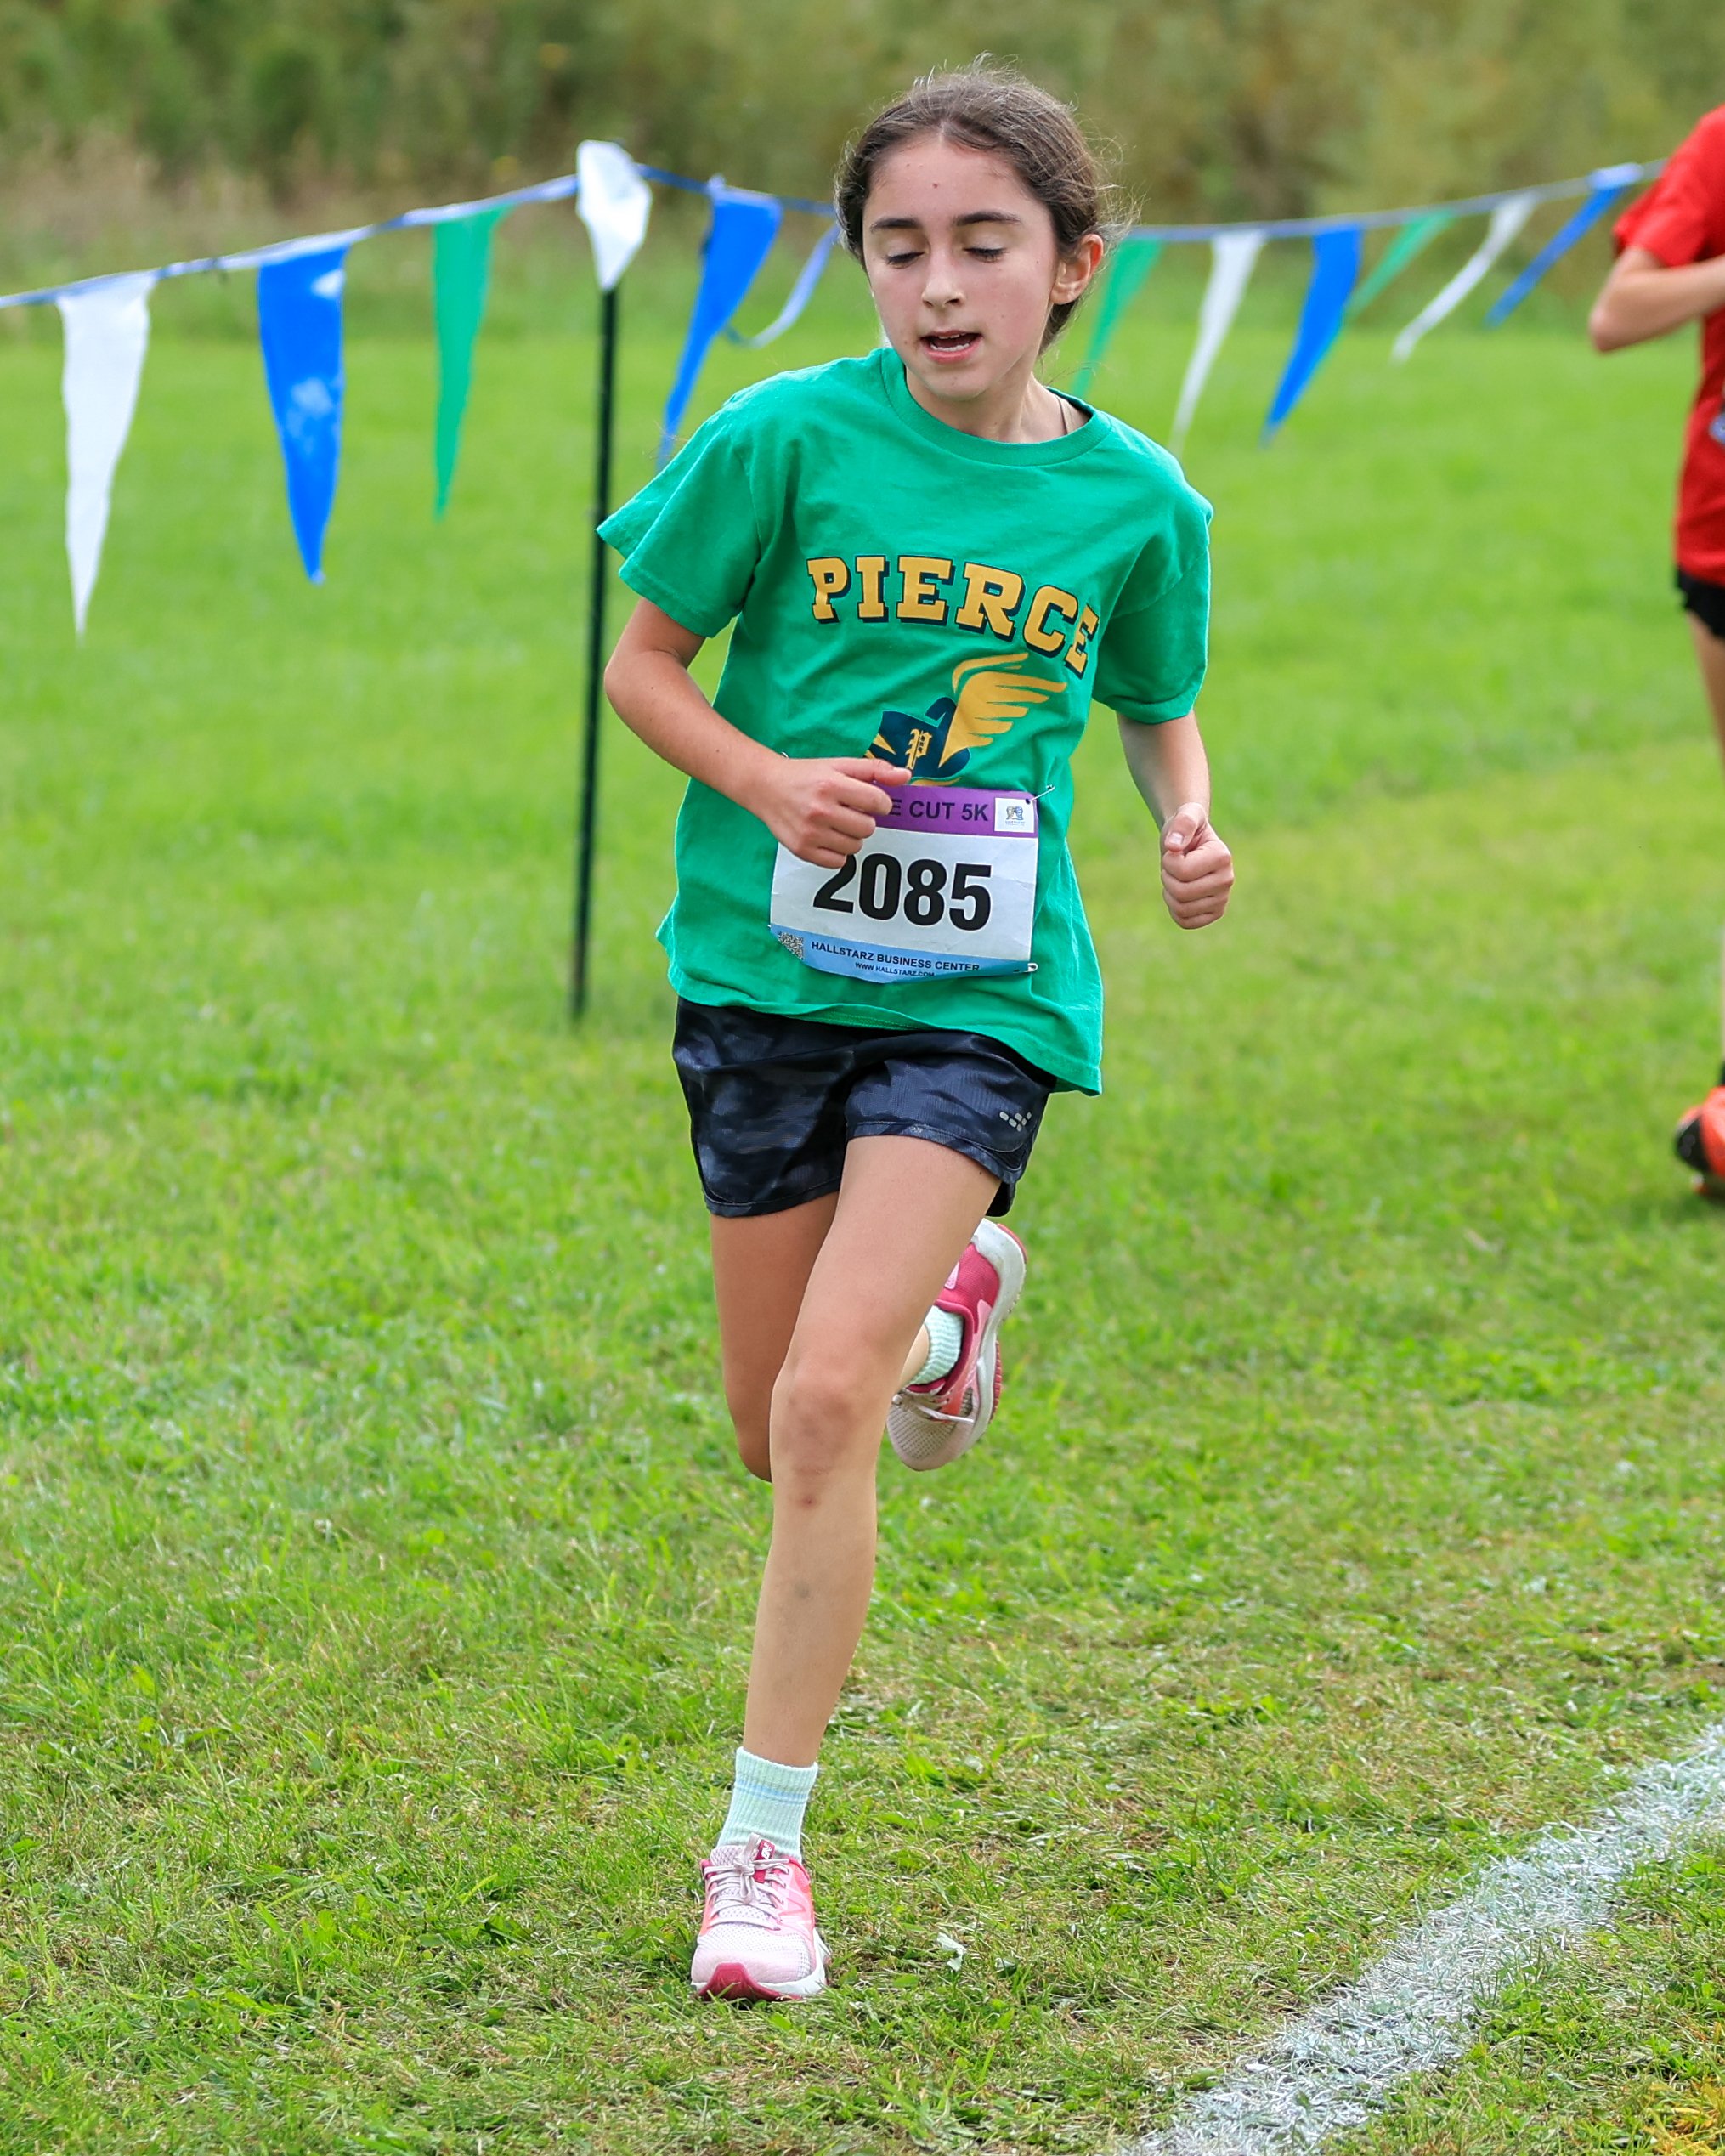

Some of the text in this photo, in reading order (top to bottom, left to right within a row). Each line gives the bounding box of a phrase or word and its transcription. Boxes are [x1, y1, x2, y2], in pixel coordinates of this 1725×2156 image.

[806, 555, 1100, 680] PIERCE
[909, 801, 956, 820] CUT
[960, 803, 989, 822] 5K
[812, 852, 993, 931] 2085
[812, 941, 981, 971] HALLSTARZ BUSINESS CENTER
[855, 961, 936, 977] WWW.HALLSTARZ.COM
